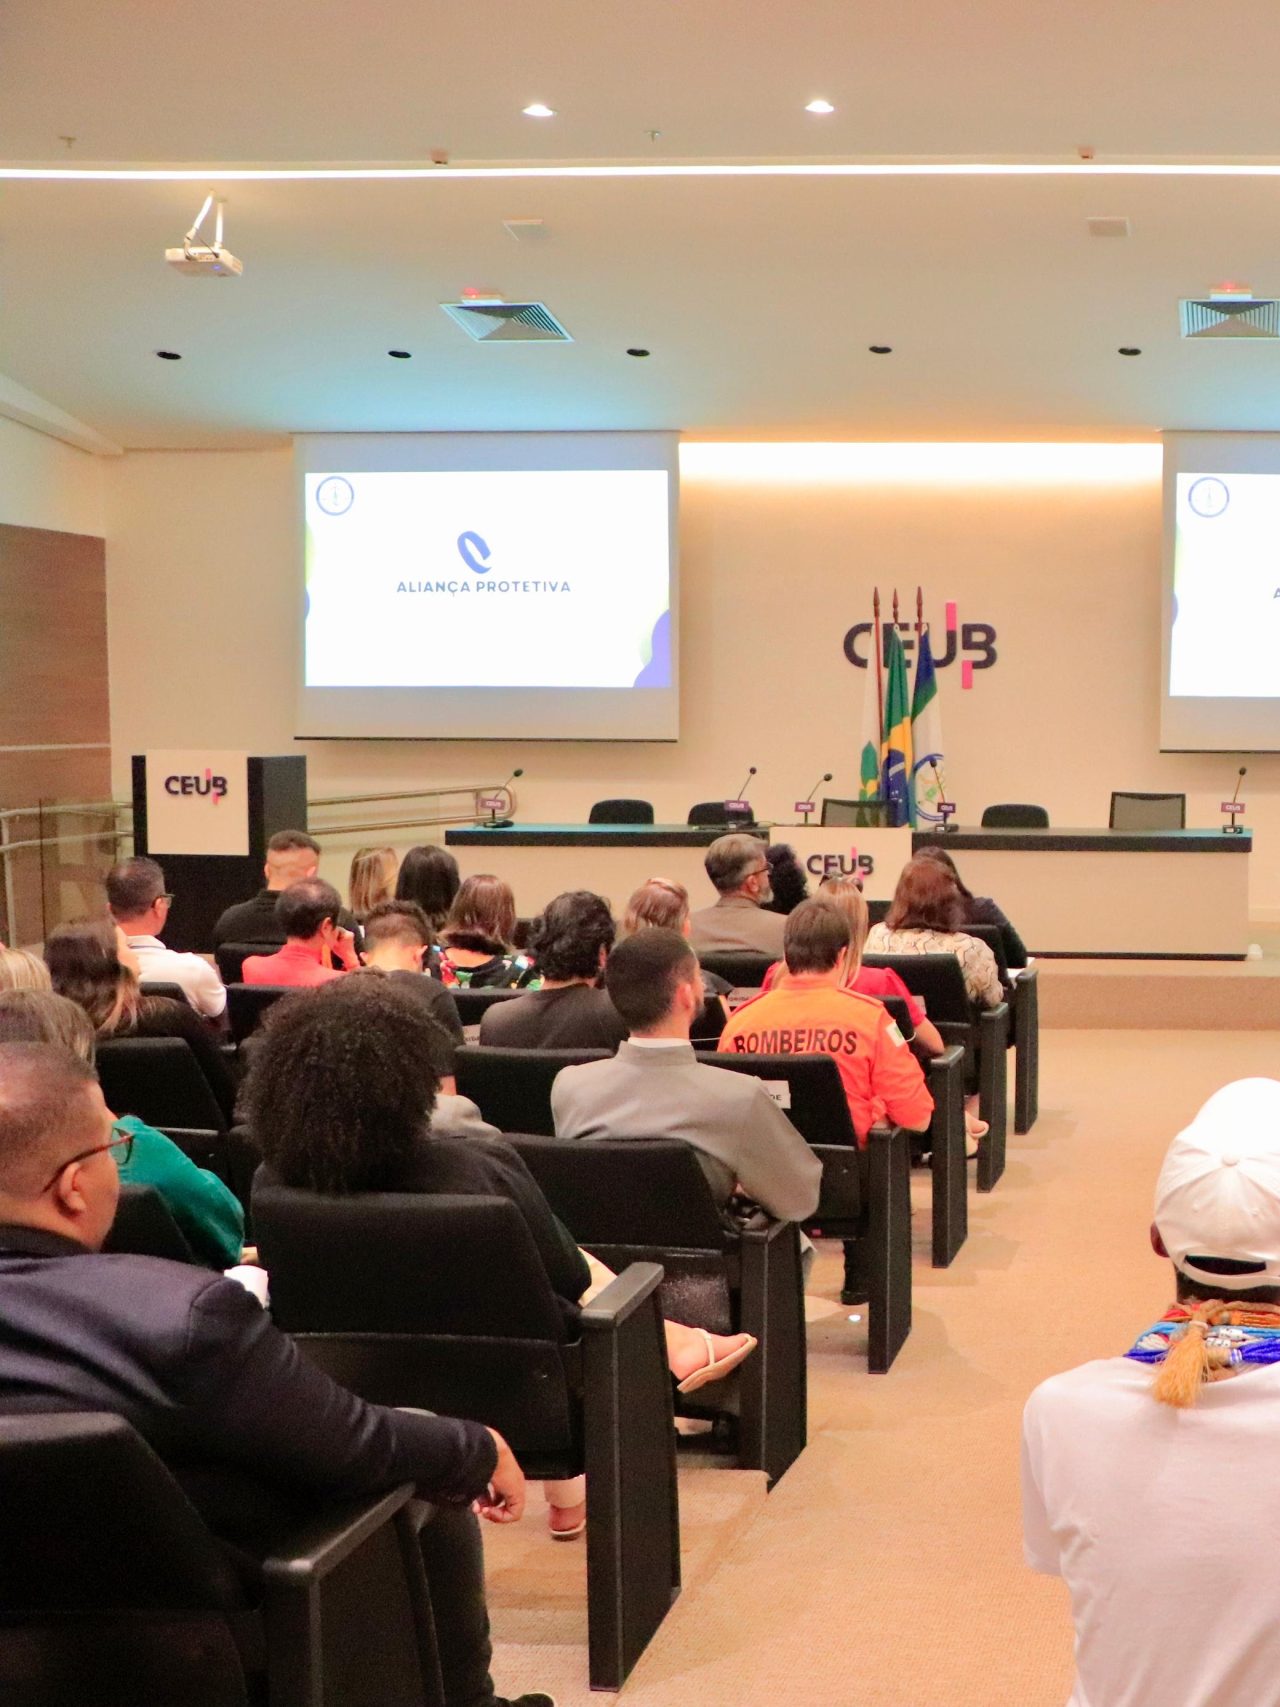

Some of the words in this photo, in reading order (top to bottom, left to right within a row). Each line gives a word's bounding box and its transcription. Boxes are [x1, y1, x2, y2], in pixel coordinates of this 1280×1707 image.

[396, 580, 471, 597] ALIANÇA
[476, 580, 572, 593] PROTETIVA
[843, 602, 998, 690] CEUB
[164, 768, 228, 806] CEUB
[806, 847, 874, 882] CEUB
[733, 1029, 858, 1055] BOMBEIROS
